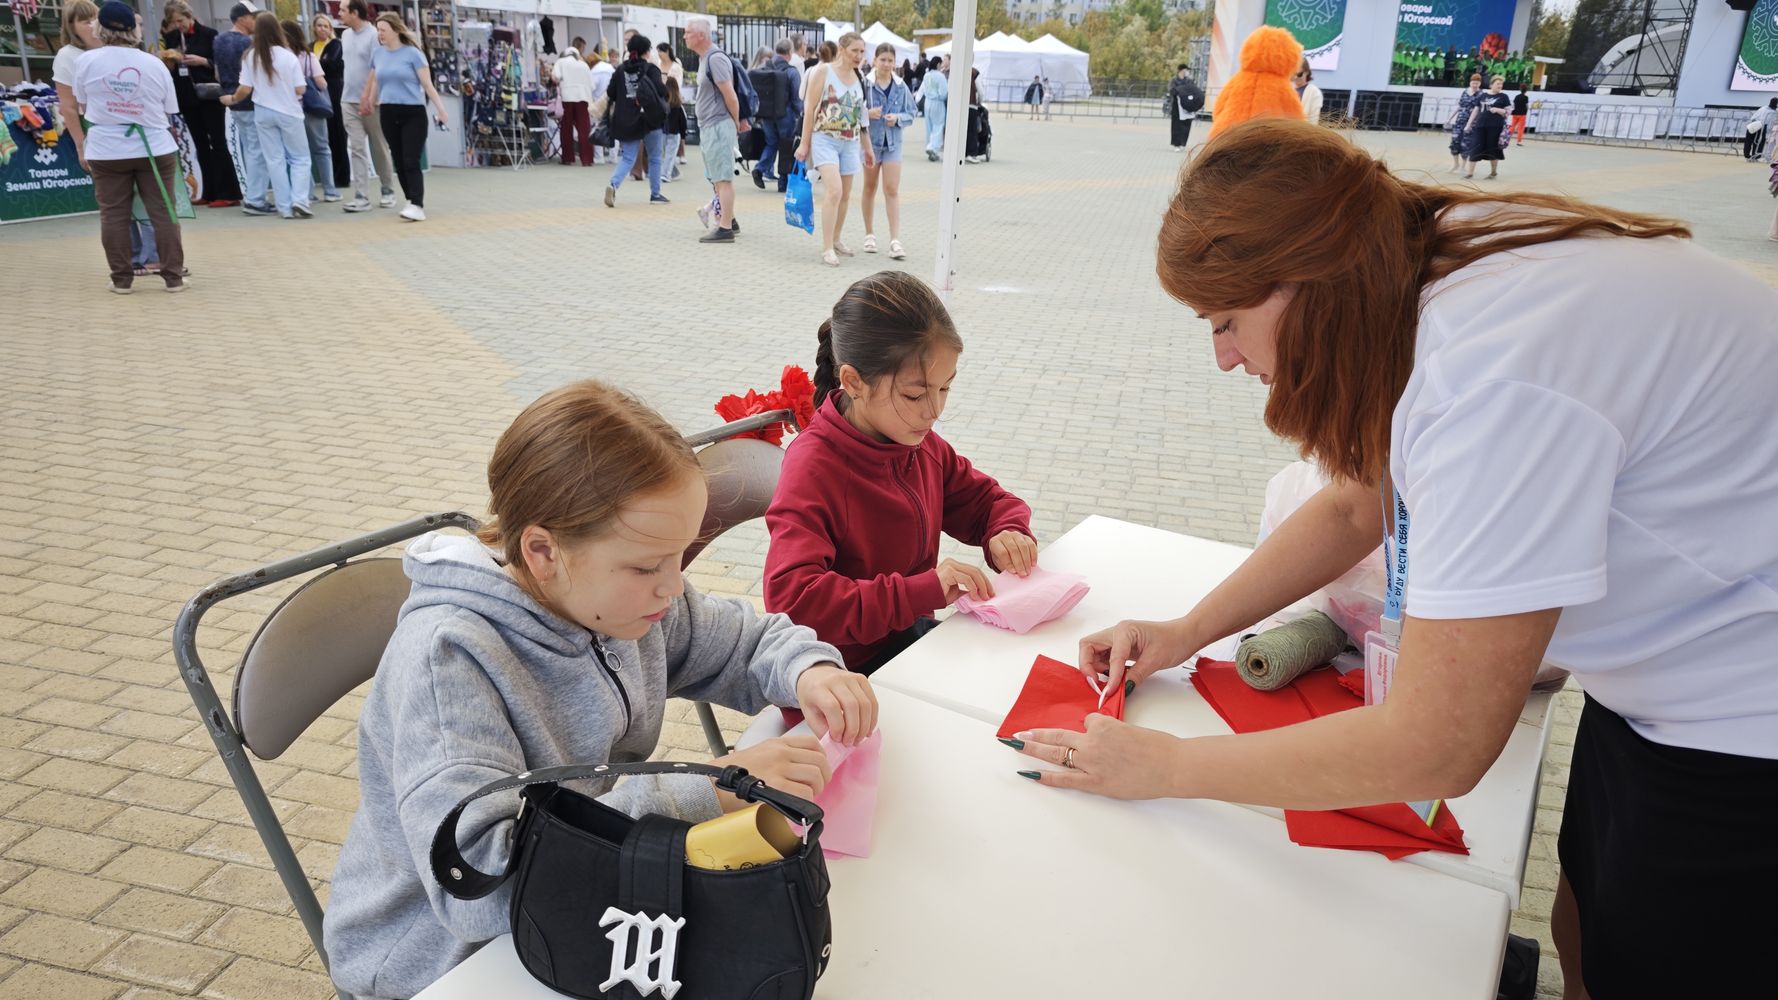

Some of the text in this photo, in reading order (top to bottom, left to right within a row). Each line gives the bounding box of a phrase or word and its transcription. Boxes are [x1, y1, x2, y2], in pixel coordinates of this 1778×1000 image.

[1403, 13, 1453, 25] Югорской
[28, 168, 69, 179] Товары
[5, 175, 93, 192] Земли Югорской
[1398, 523, 1408, 545] СЕБЯ
[1397, 548, 1407, 575] ВЕСТИ
